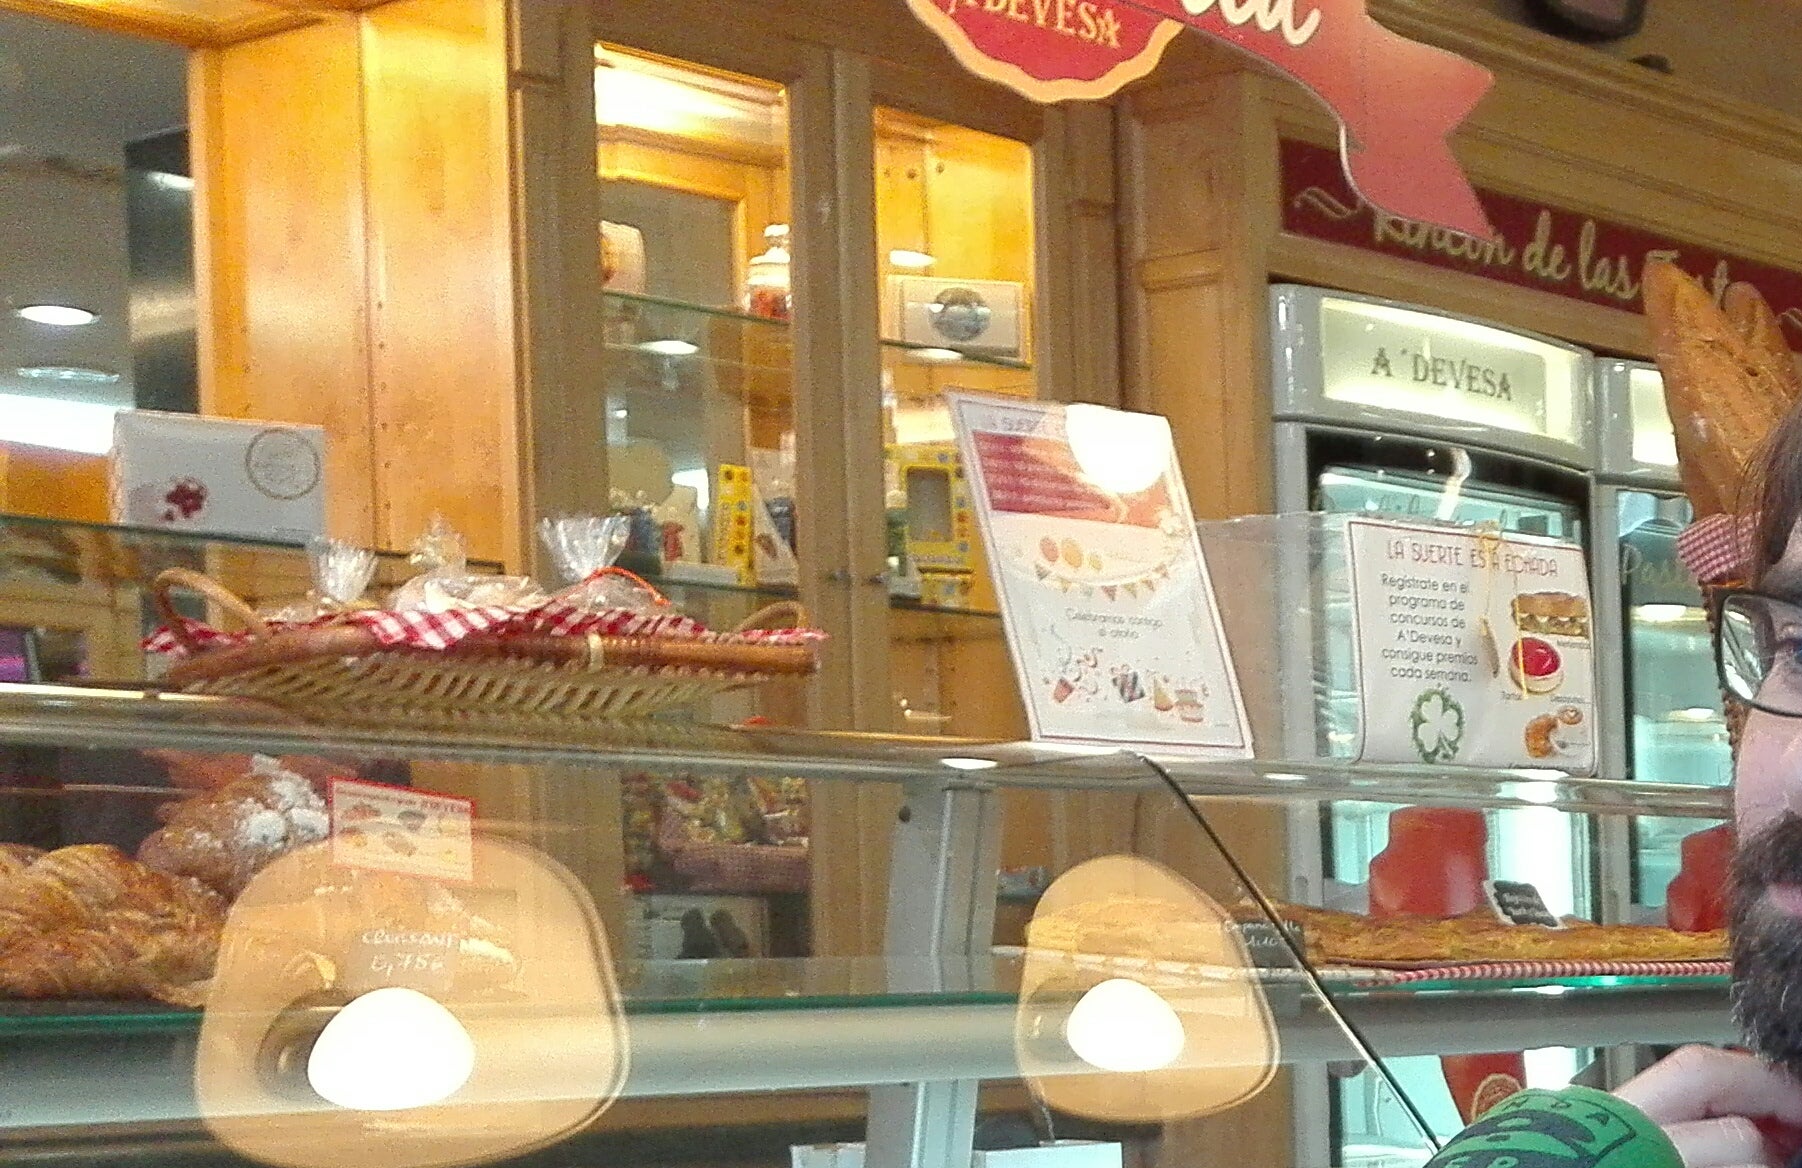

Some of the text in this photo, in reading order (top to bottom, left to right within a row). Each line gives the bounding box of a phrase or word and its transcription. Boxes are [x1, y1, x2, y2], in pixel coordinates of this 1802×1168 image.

[1521, 209, 1571, 281] de
[1577, 217, 1641, 300] las
[1387, 540, 1405, 561] LA
[1412, 542, 1464, 567] SUERTE
[1504, 552, 1558, 578] ECHADA
[1442, 582, 1458, 592] en
[1388, 594, 1465, 612] programa de
[1390, 613, 1466, 629] concursos de
[1455, 636, 1463, 648] y
[1381, 647, 1478, 666] consigue premios
[1391, 666, 1422, 679] cada
